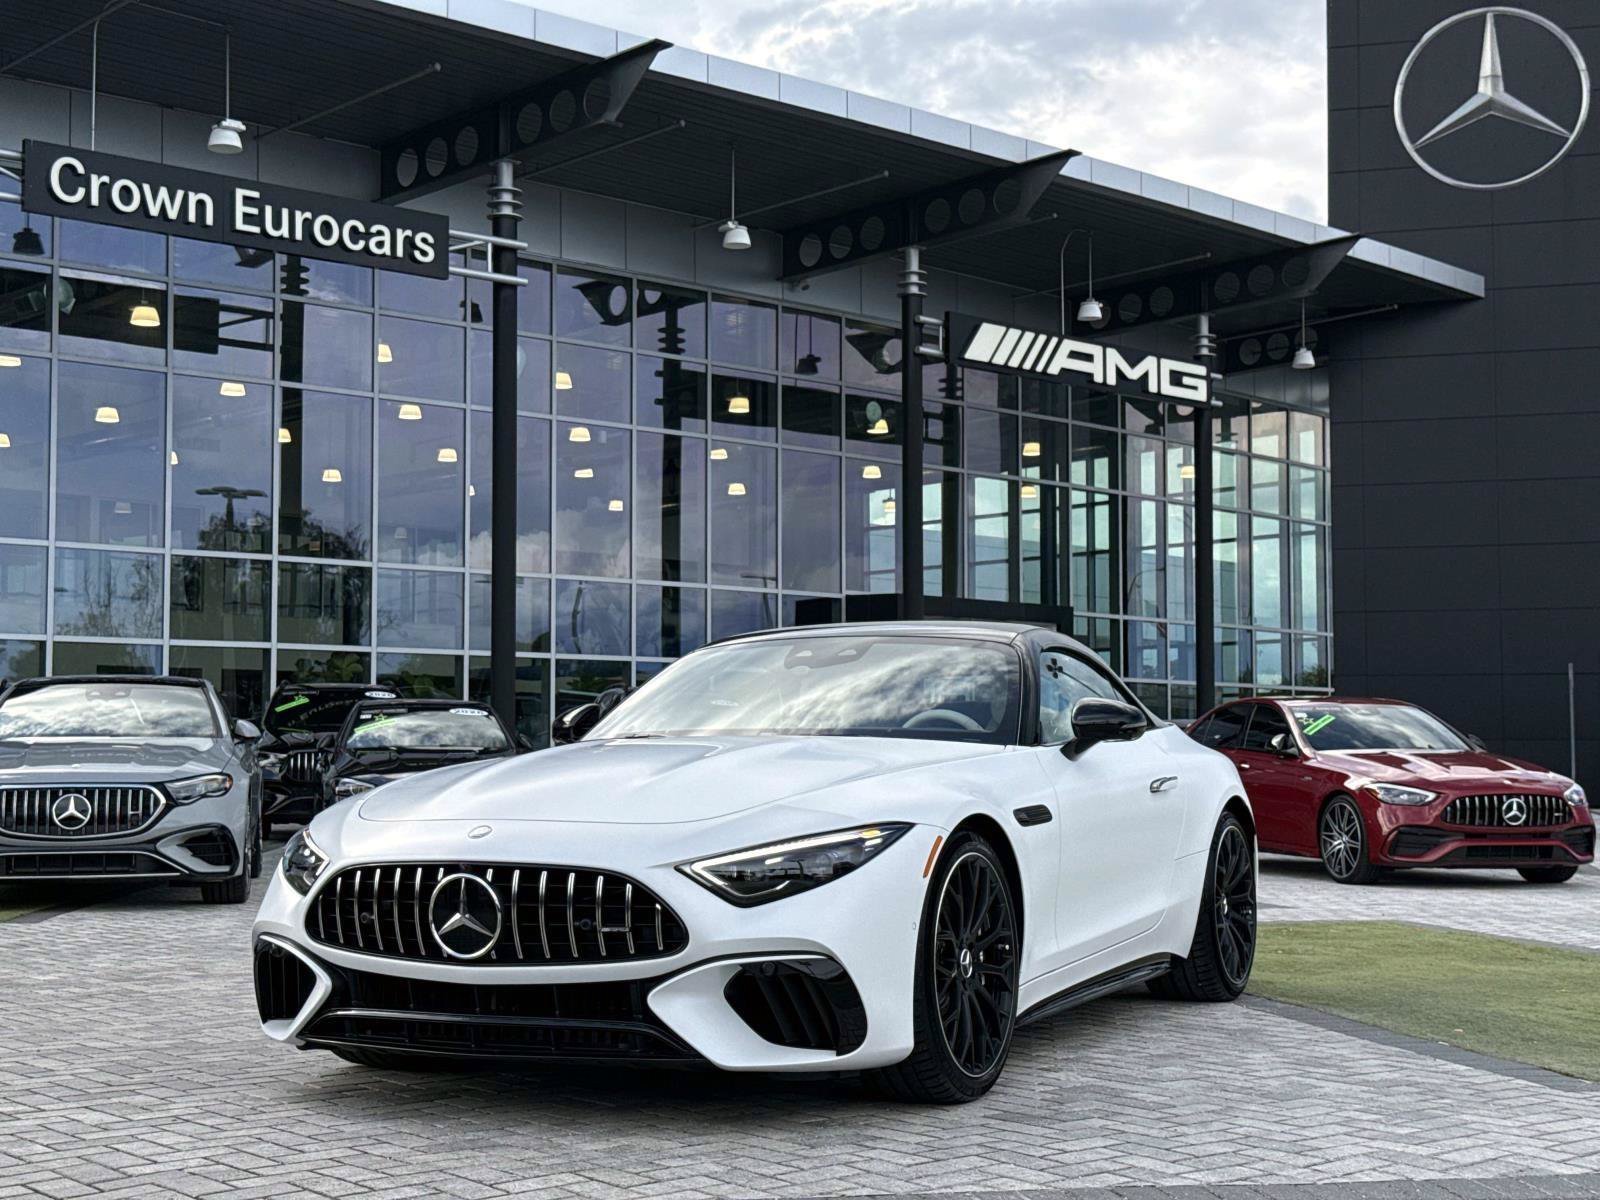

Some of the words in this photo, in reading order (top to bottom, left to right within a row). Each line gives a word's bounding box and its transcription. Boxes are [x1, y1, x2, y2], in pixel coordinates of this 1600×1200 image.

[49, 156, 214, 227] Crown
[234, 187, 436, 264] Eurocars
[1046, 337, 1208, 402] AMG
